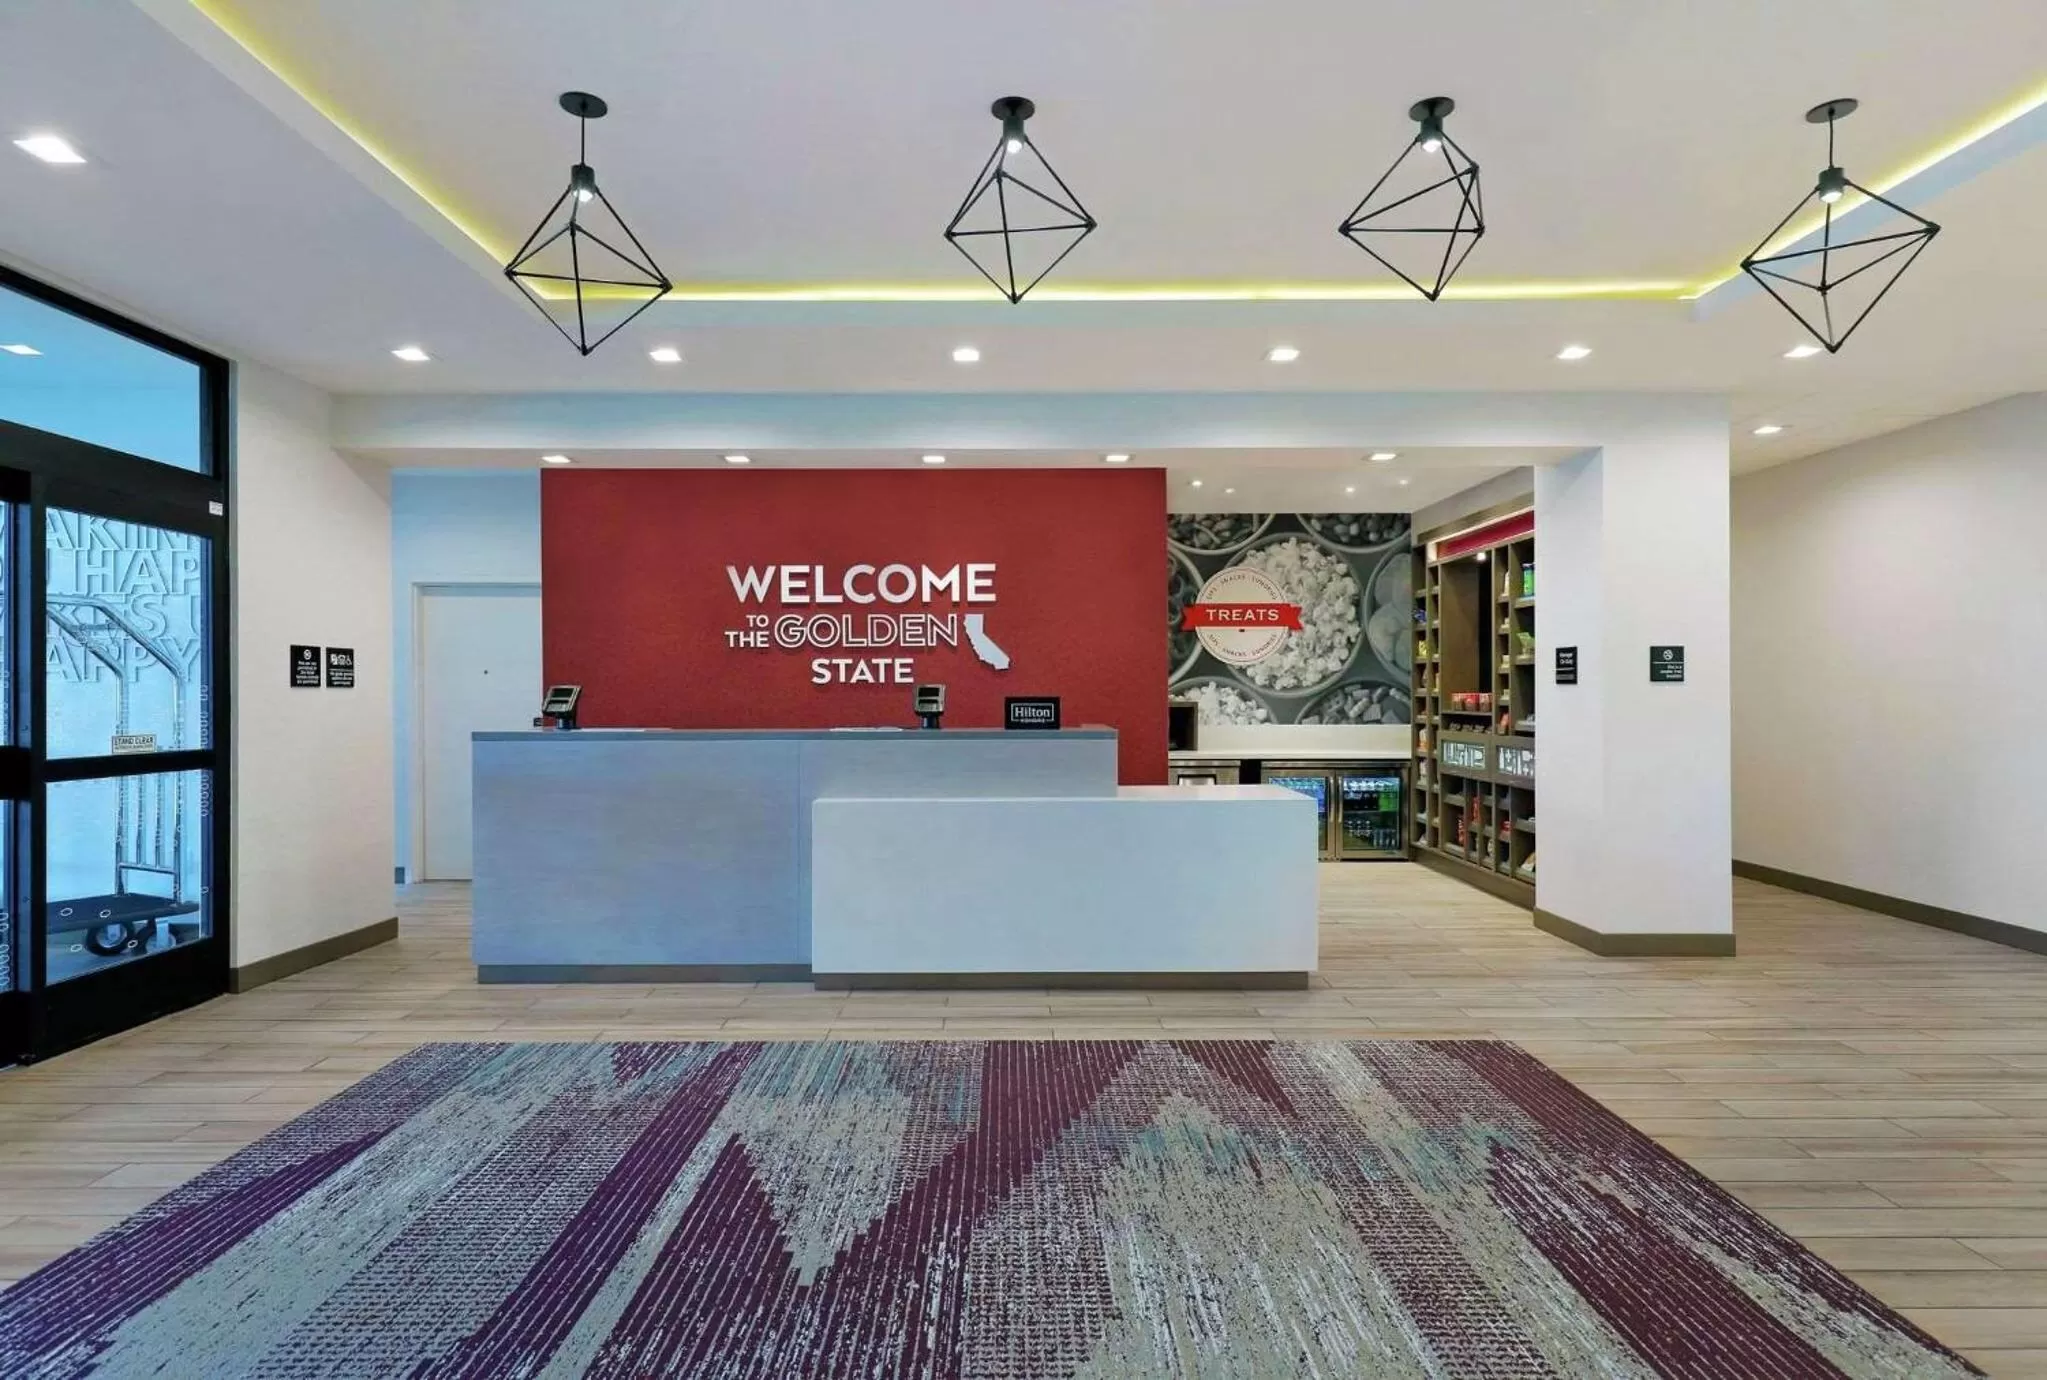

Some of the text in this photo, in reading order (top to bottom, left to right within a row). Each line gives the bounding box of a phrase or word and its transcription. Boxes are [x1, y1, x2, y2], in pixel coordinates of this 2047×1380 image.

[726, 563, 997, 604] WELCOME
[746, 615, 770, 628] TO
[1206, 609, 1280, 621] TREATS
[724, 613, 958, 648] THE GOLDEN
[811, 657, 915, 684] STATE
[1015, 706, 1050, 717] Hilton
